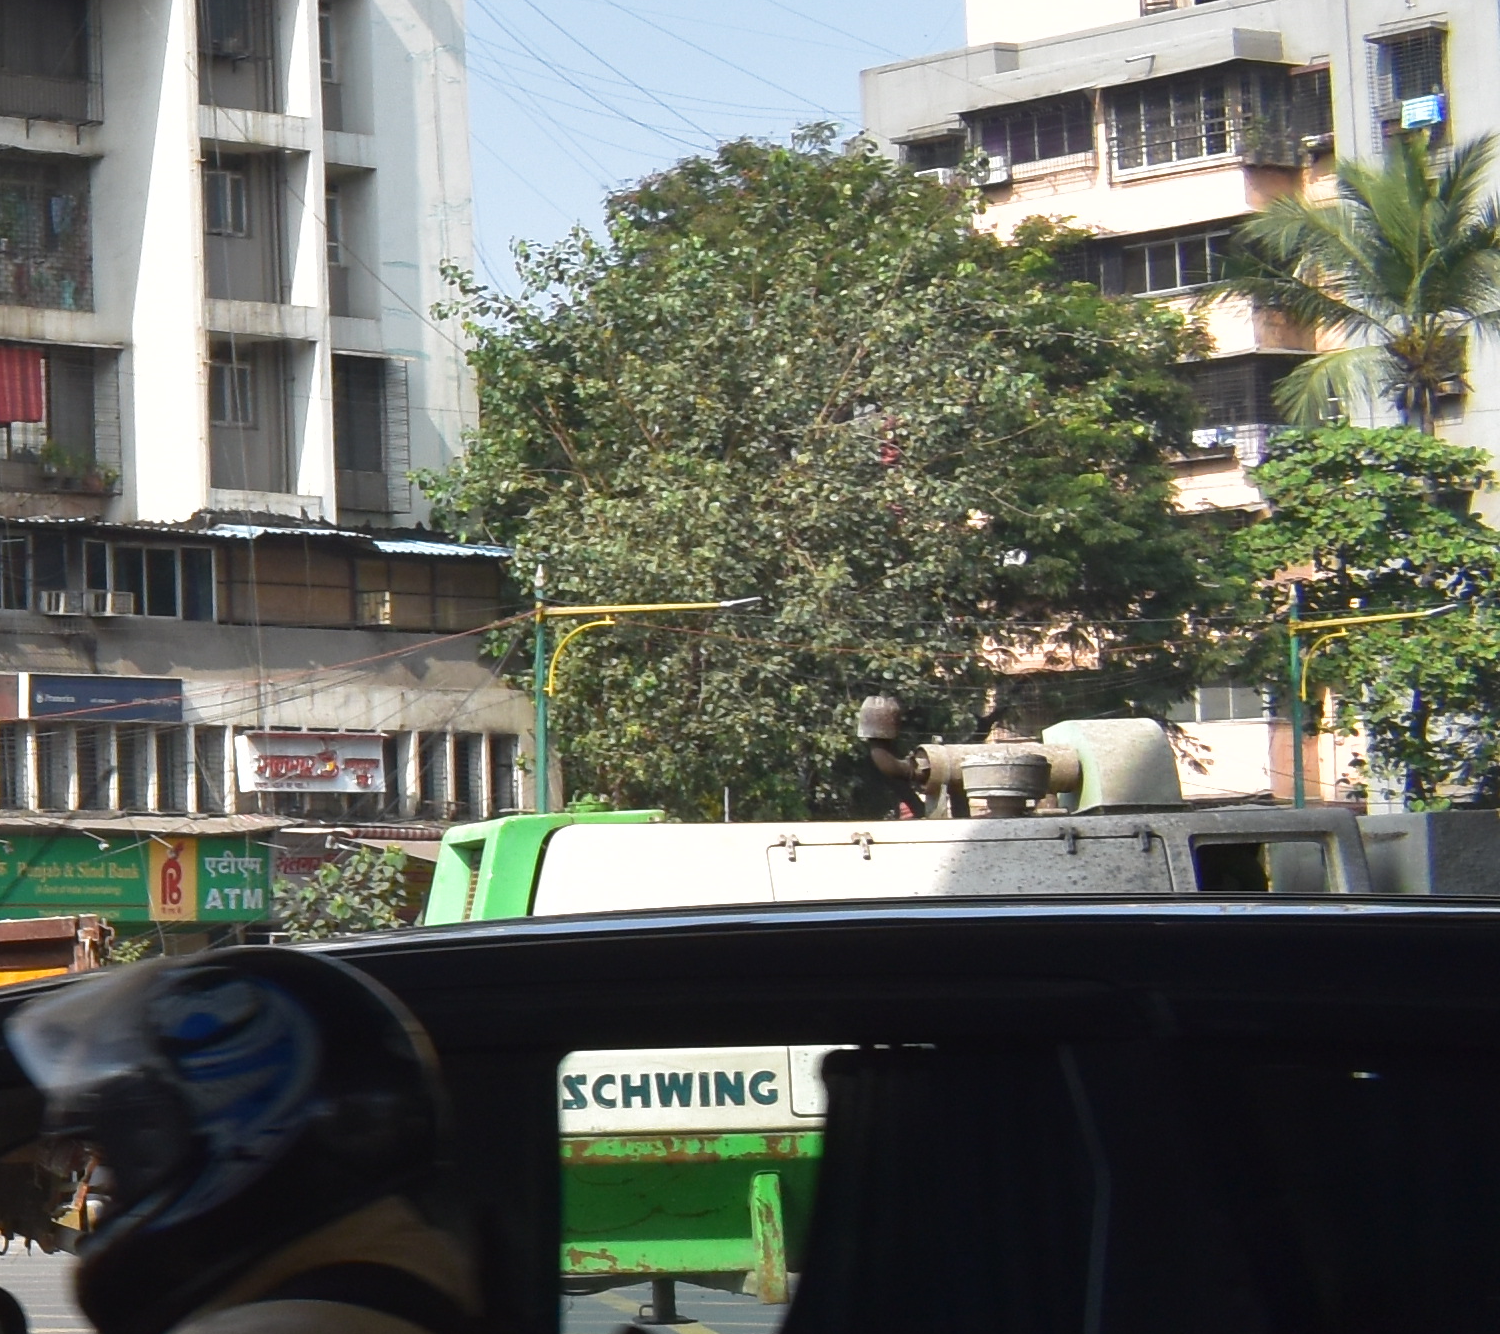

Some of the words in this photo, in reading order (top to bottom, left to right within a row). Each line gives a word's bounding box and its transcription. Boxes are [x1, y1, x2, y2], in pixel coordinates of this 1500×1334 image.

[109, 861, 140, 879] Bank
[204, 850, 263, 878] एटीएम
[204, 888, 263, 909] ATM
[562, 1070, 779, 1110] SCHWING
